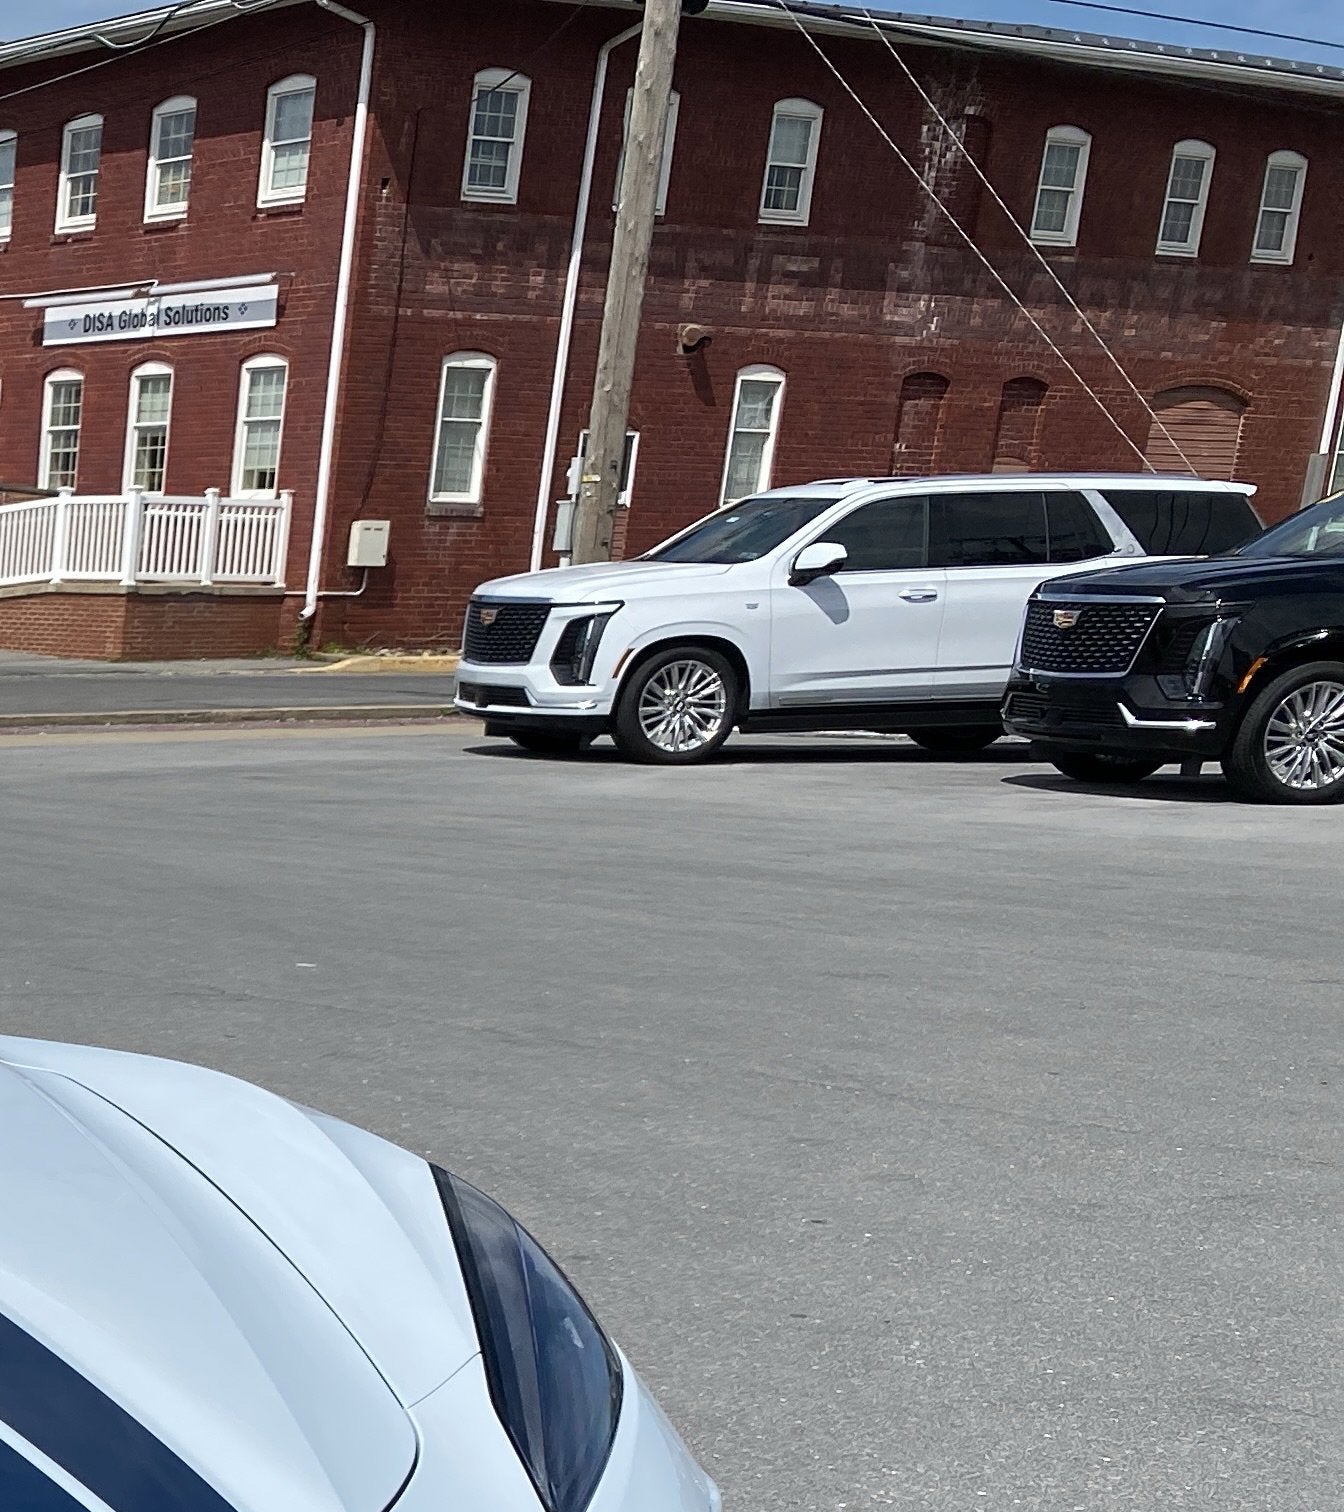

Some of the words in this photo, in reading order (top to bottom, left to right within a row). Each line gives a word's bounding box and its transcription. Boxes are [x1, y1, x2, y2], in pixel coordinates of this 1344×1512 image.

[83, 309, 114, 333] DISA
[118, 307, 161, 330] Global
[164, 303, 229, 325] Solutions
